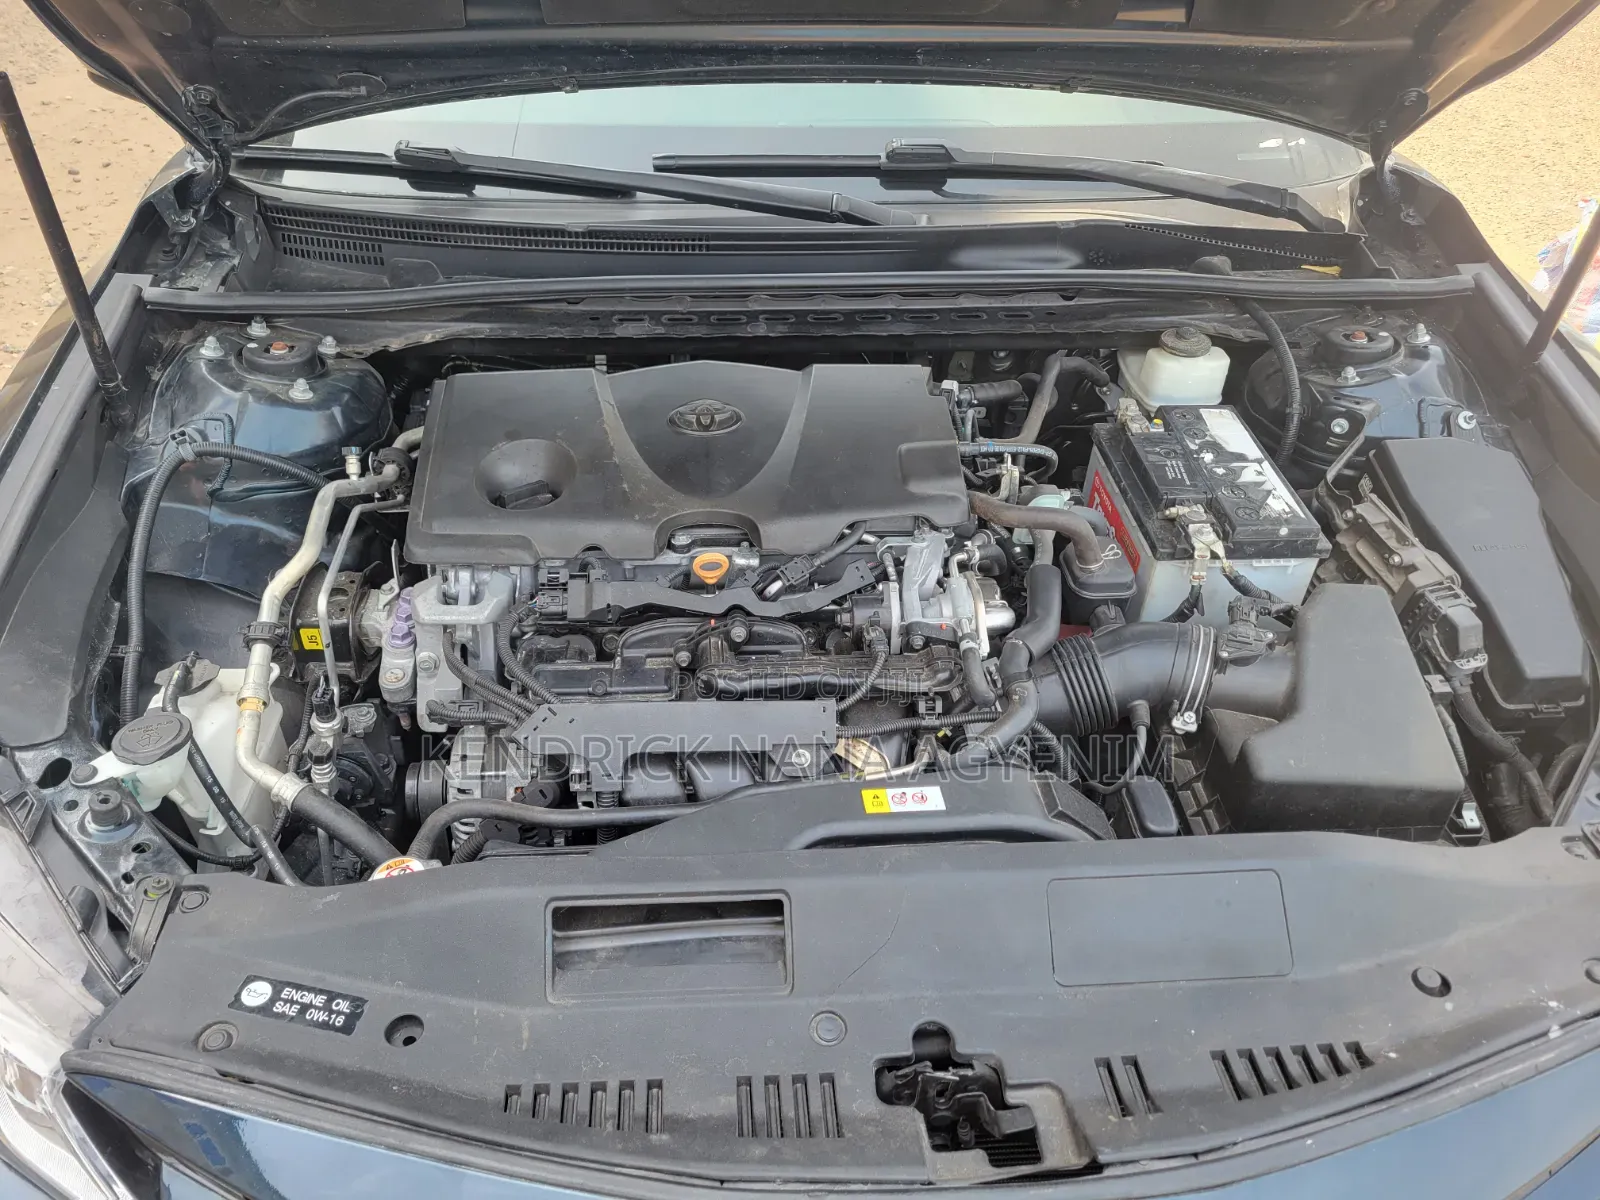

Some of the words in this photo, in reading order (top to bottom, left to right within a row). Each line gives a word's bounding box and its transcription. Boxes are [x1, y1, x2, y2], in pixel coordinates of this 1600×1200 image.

[1099, 486, 1112, 514] TOYOTA
[307, 634, 319, 646] J5
[280, 987, 327, 1007] ENGINE
[332, 999, 351, 1012] OIL
[272, 1001, 301, 1016] SAE
[305, 1008, 345, 1027] 0W-16
